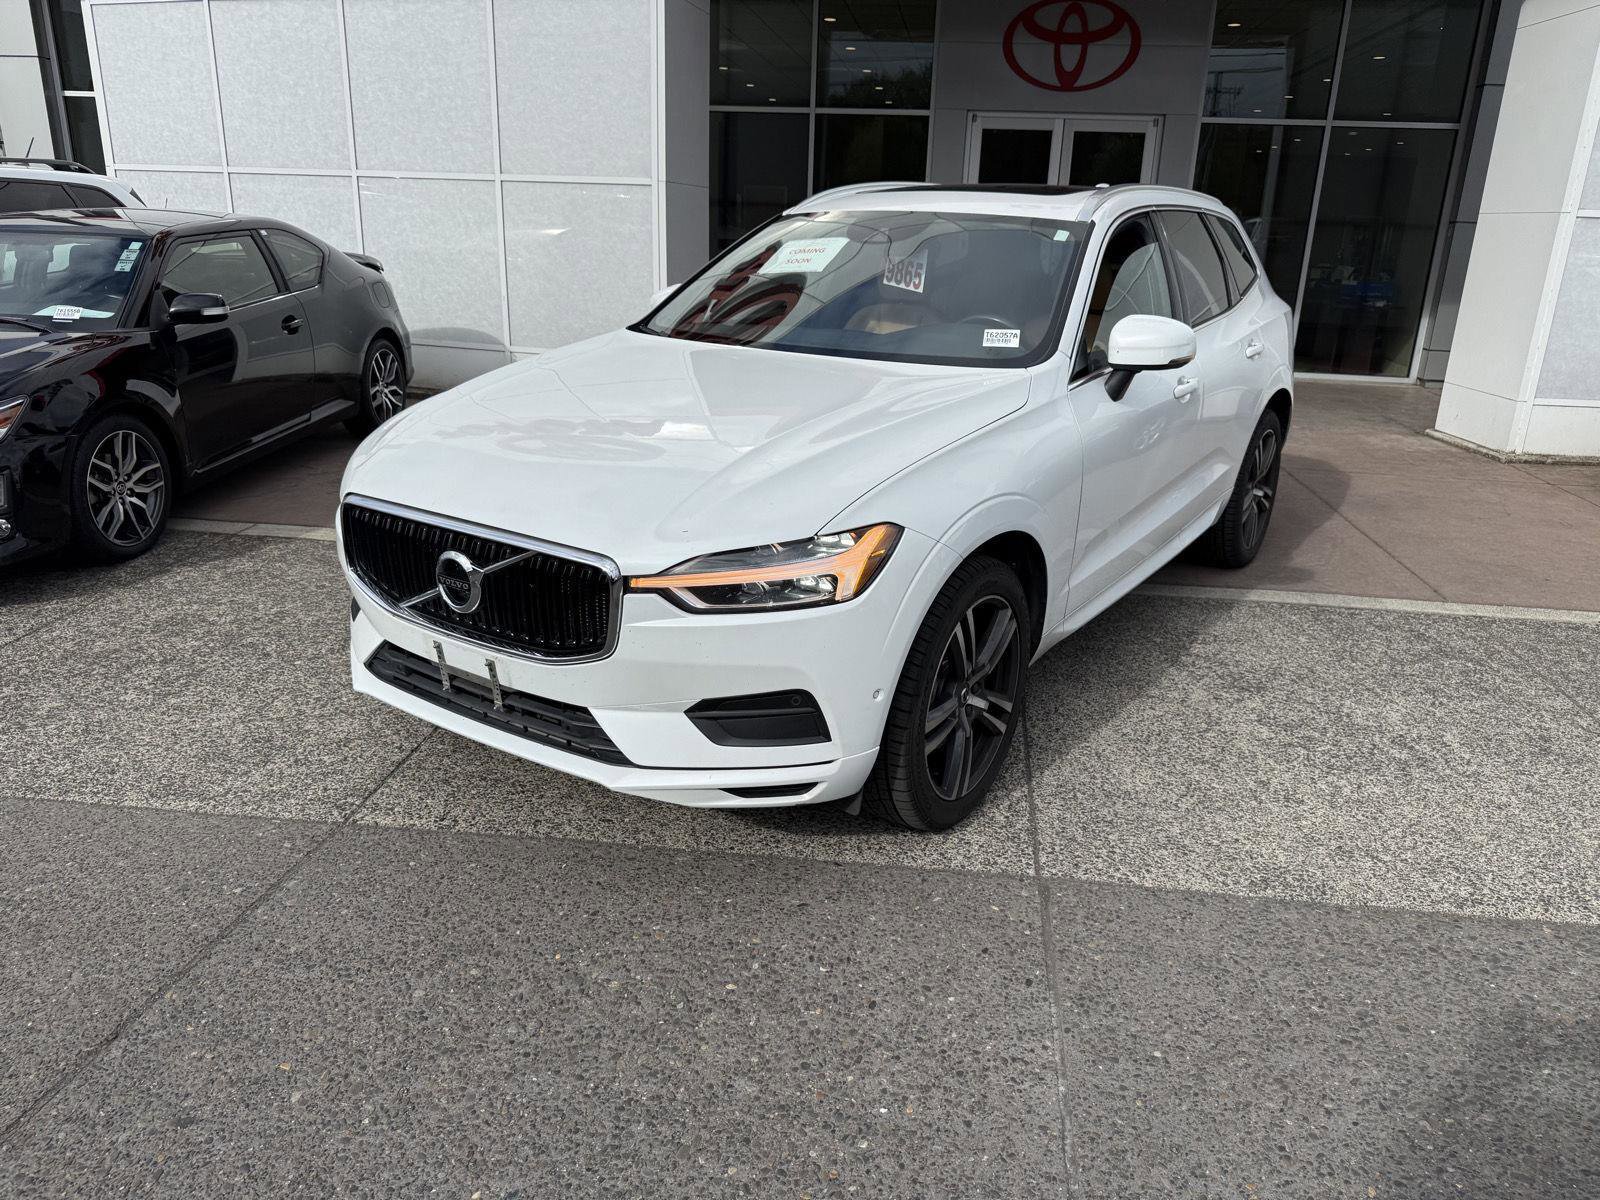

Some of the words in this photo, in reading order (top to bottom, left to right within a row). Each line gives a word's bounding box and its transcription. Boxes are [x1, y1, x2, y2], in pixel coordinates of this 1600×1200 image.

[789, 247, 826, 255] COMING
[885, 260, 924, 290] 9865
[986, 331, 1018, 339] T62057A
[438, 576, 469, 590] VOLVO
